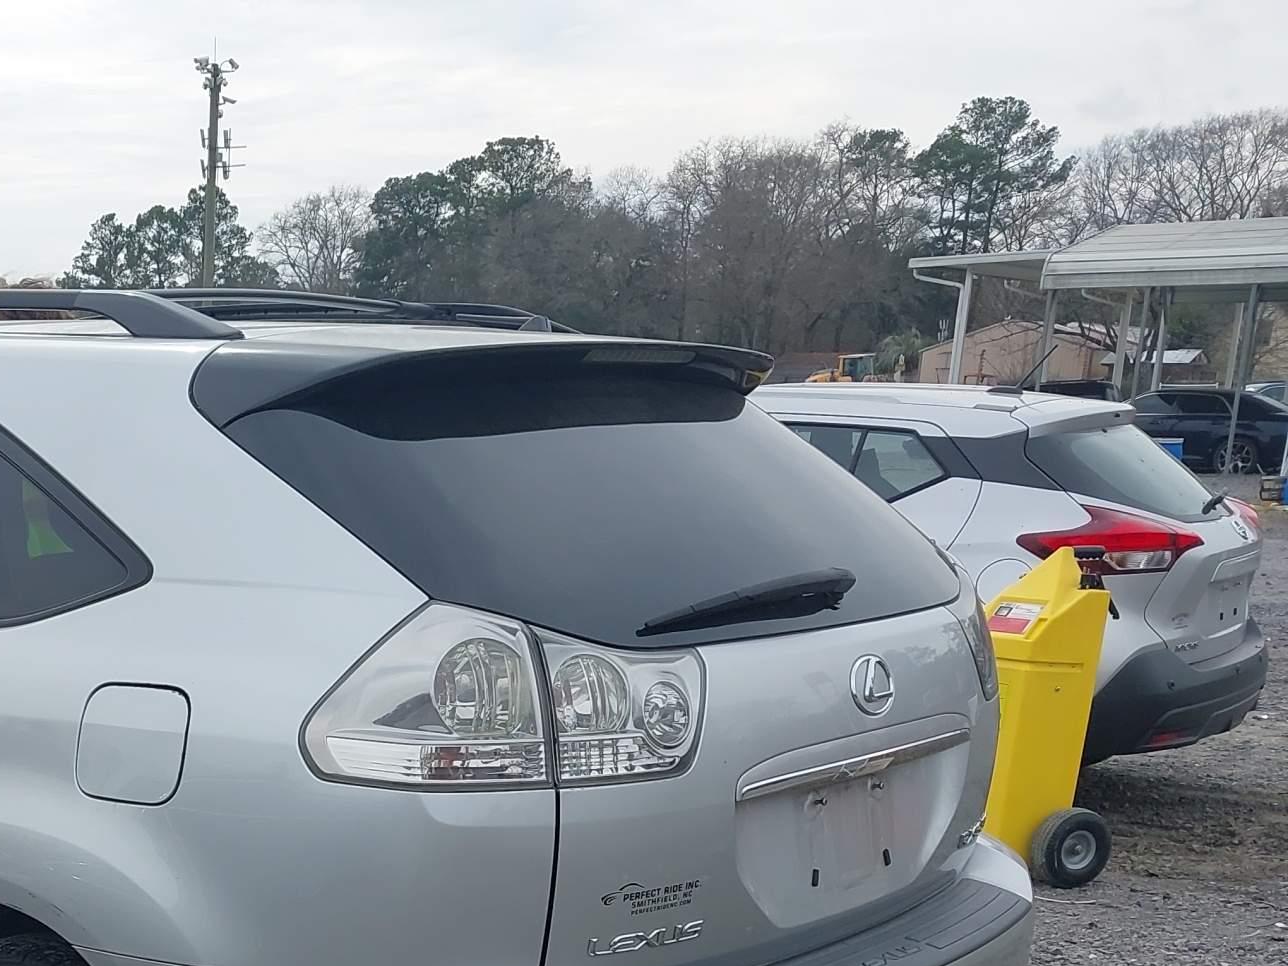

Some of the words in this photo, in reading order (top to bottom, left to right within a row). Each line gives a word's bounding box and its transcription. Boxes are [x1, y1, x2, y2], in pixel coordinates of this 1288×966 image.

[623, 888, 662, 902] PERFECT
[663, 884, 684, 896] RIDE
[686, 880, 702, 892] INC.
[631, 893, 680, 909] SMITHFIELD,
[682, 890, 693, 899] NC
[587, 919, 704, 957] LEXUS
